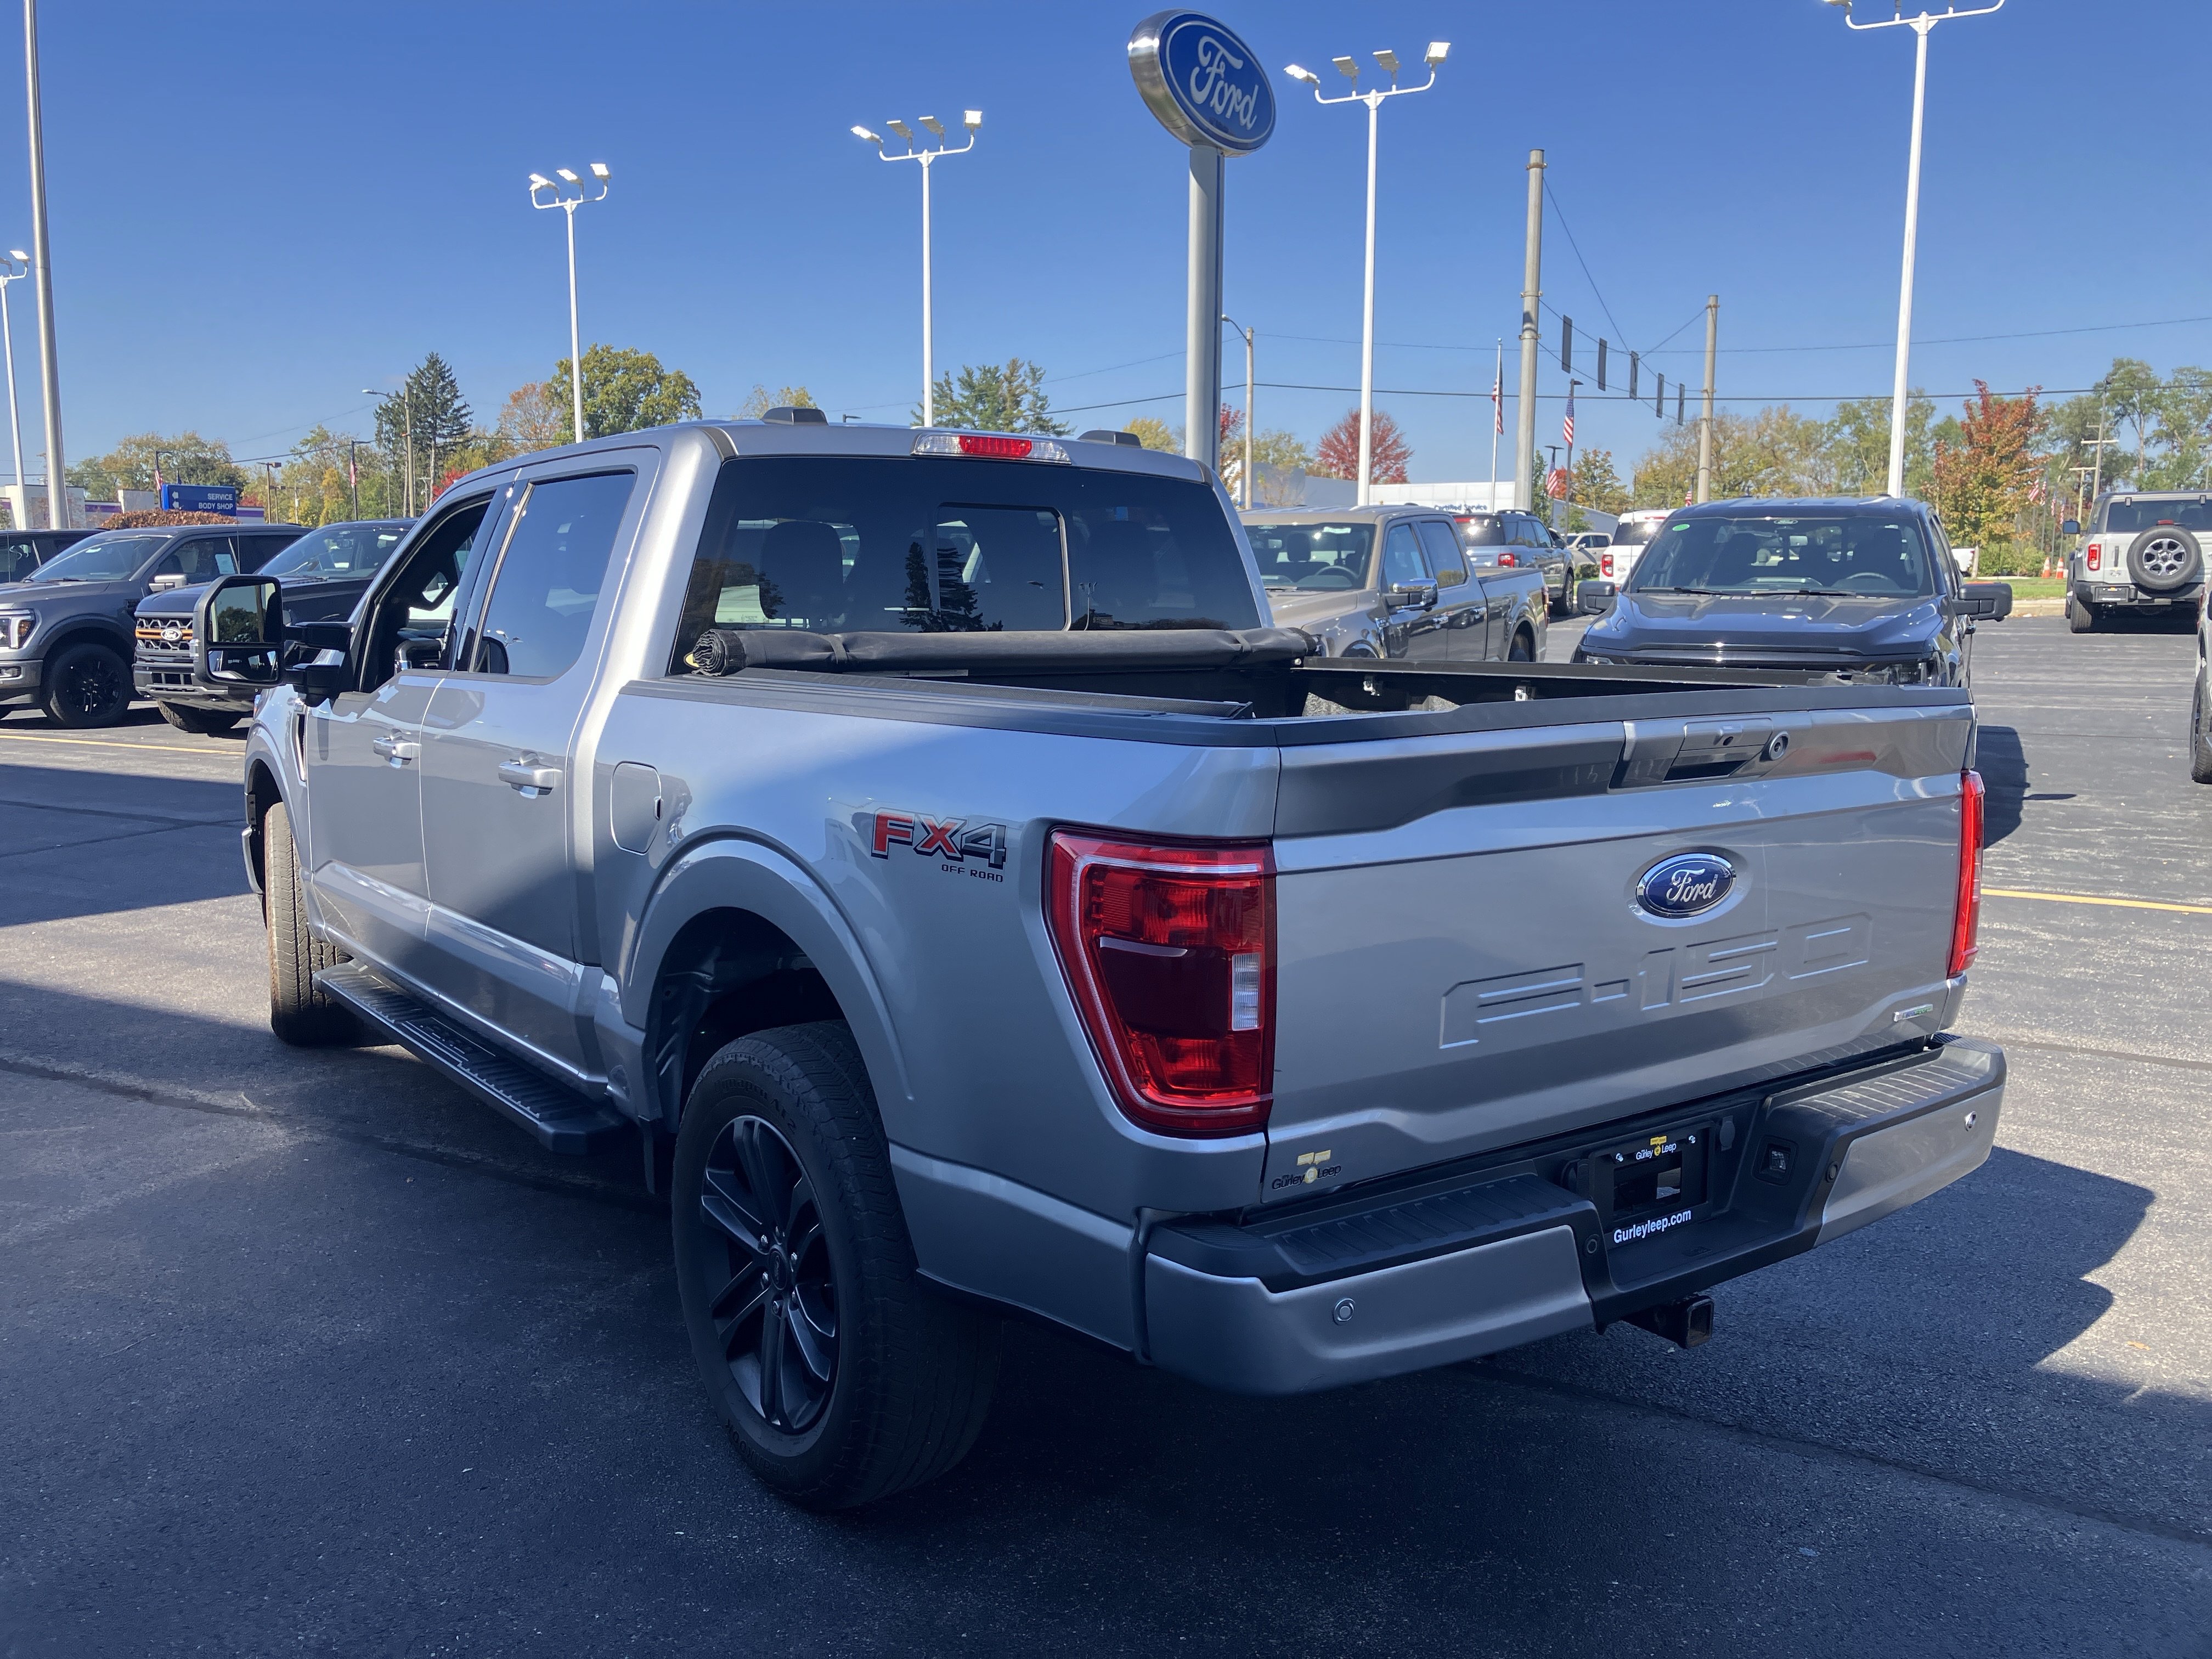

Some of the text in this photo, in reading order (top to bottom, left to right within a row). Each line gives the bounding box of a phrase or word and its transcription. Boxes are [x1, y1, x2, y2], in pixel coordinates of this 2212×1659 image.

[1190, 35, 1259, 130] Ford
[871, 809, 1007, 870] FX4
[941, 864, 1003, 883] OFF ROAD
[1666, 868, 1719, 906] Ford
[1439, 911, 1873, 1049] F-150
[1636, 1143, 1677, 1160] Gurley Leep
[1272, 1165, 1341, 1190] Gurley Leep
[1613, 1210, 1691, 1243] Gurleyleep.com
